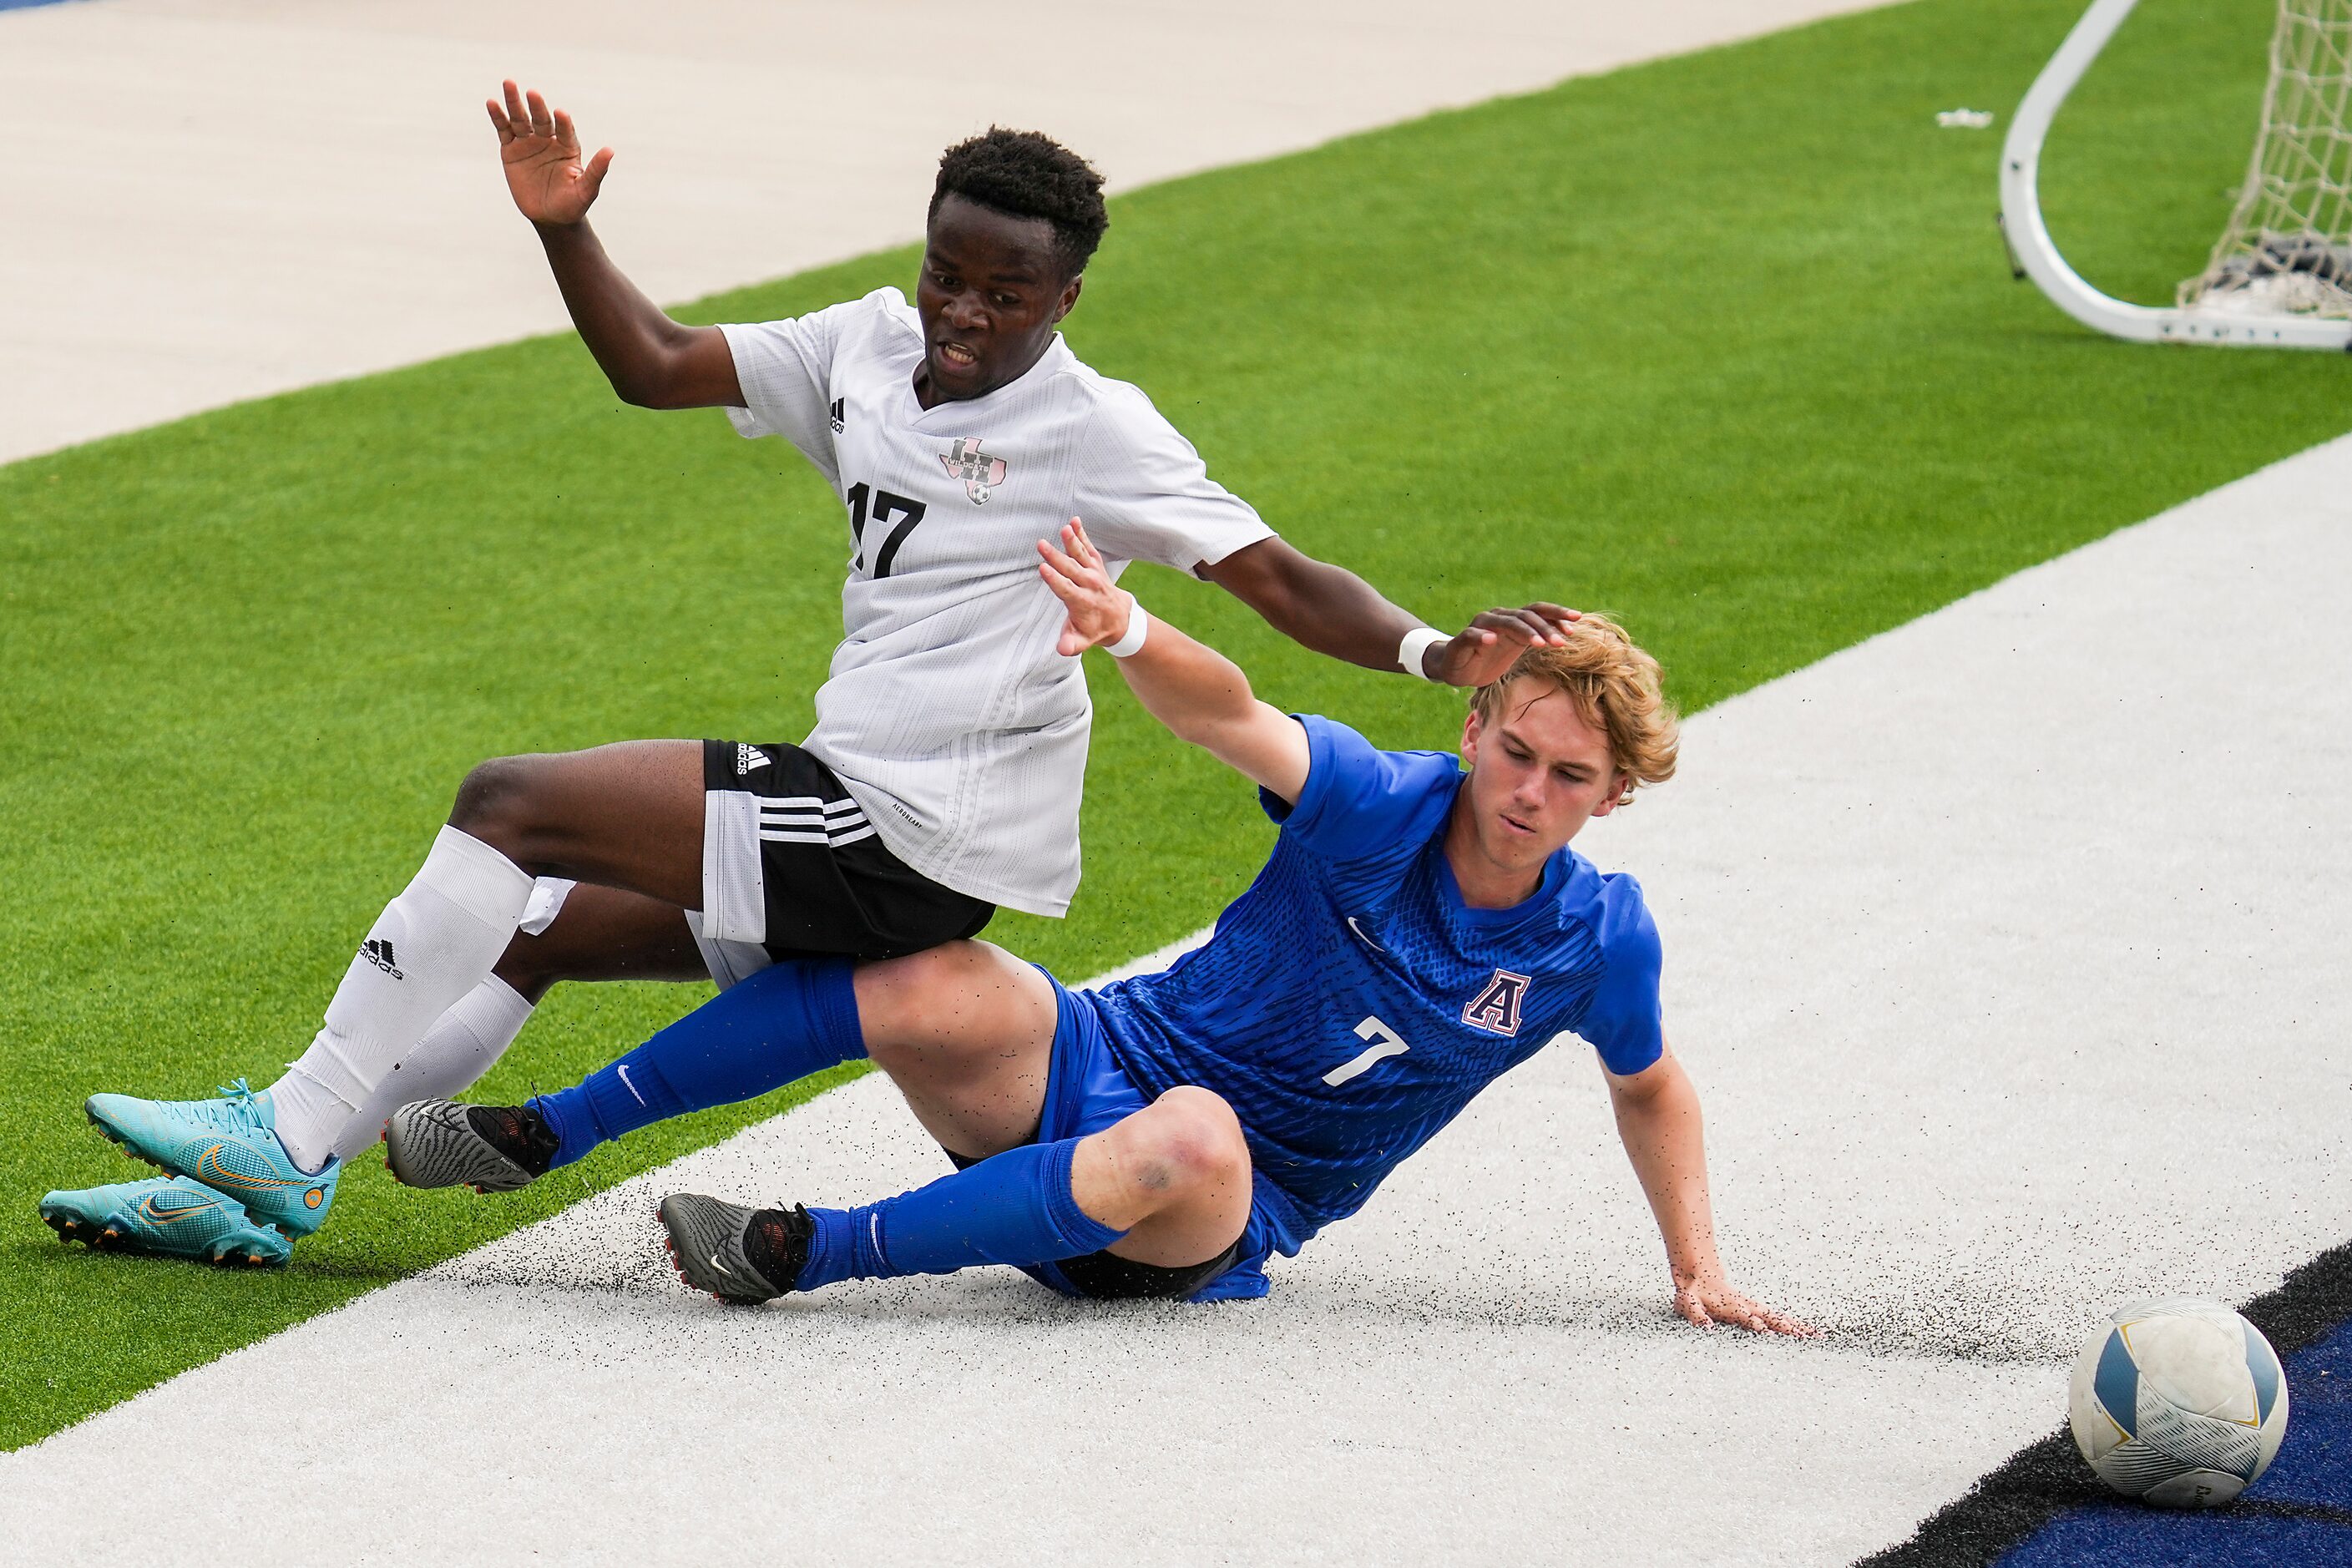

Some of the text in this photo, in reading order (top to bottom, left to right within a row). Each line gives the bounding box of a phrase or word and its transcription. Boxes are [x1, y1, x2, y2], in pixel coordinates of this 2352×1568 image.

[948, 458, 989, 473] WILDCATS
[847, 481, 927, 579] 17
[736, 742, 748, 775] adidas
[892, 802, 923, 828] AEROREADY
[359, 948, 404, 980] didas
[1461, 968, 1532, 1038] A
[1322, 1014, 1411, 1087] 7
